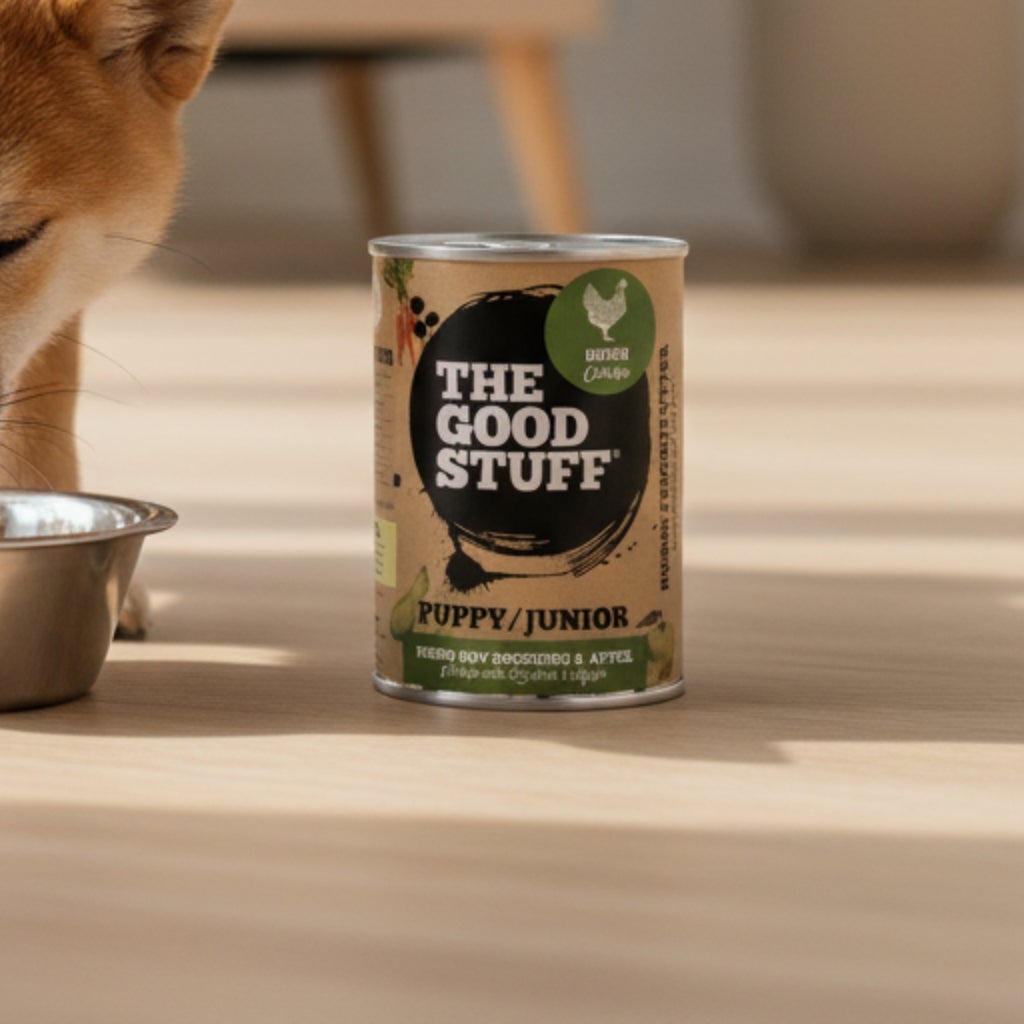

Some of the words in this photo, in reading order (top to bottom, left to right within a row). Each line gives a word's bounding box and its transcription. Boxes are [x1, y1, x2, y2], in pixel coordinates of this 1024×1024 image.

[435, 360, 544, 403] THE
[435, 403, 590, 449] GOOD
[435, 447, 612, 493] STUFF
[417, 600, 629, 638] PUPPY/JUNIOR
